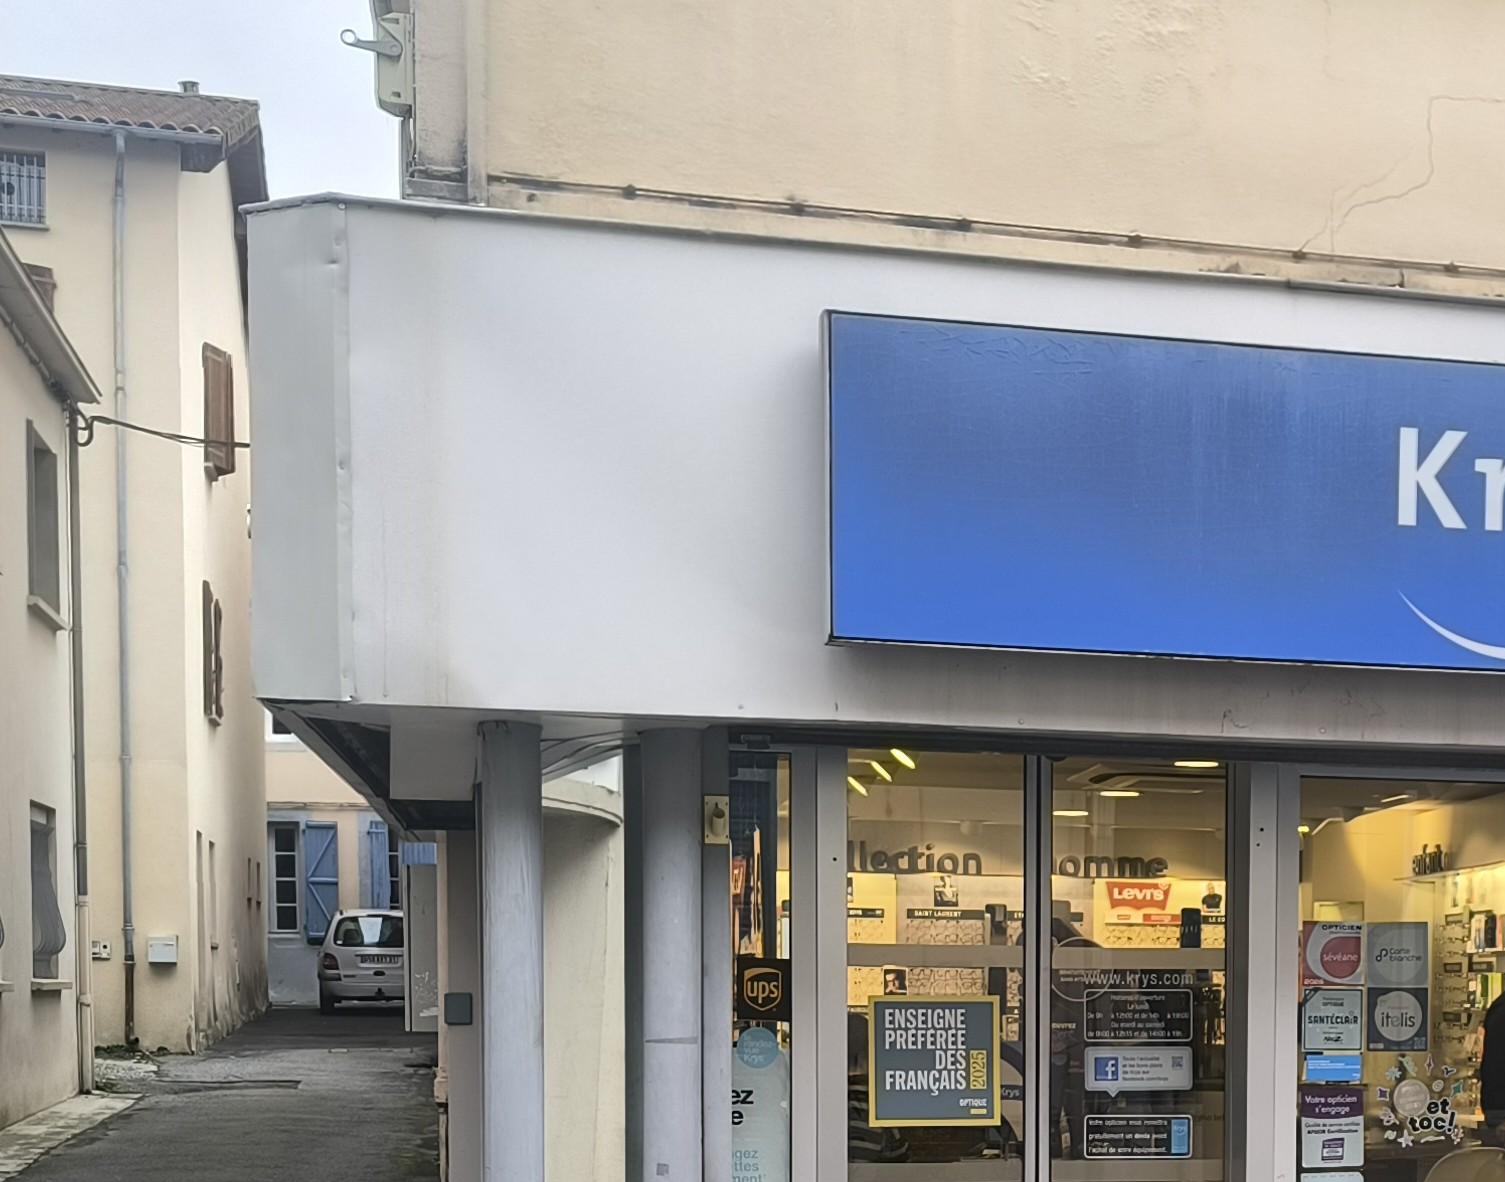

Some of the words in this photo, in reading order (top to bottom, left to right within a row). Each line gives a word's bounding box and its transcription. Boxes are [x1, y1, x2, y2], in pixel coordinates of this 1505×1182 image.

[1084, 971, 1194, 987] www.krys.com
[747, 981, 778, 1004] ups
[884, 1008, 966, 1028] ENSEIGNE
[1308, 1013, 1359, 1025] SANTÉCLAIR
[1381, 1012, 1416, 1028] itelis
[885, 1028, 966, 1049] PRÉFÉRÉE
[935, 1051, 966, 1070] DES
[971, 1051, 986, 1088] 2025
[885, 1070, 966, 1096] FRANÇAIS
[1305, 1095, 1326, 1104] Votre
[1327, 1095, 1357, 1105] opticien
[1427, 1098, 1449, 1115] et
[1315, 1105, 1350, 1115] s'engage
[1409, 1111, 1455, 1133] toc!
[732, 1149, 759, 1161] gez
